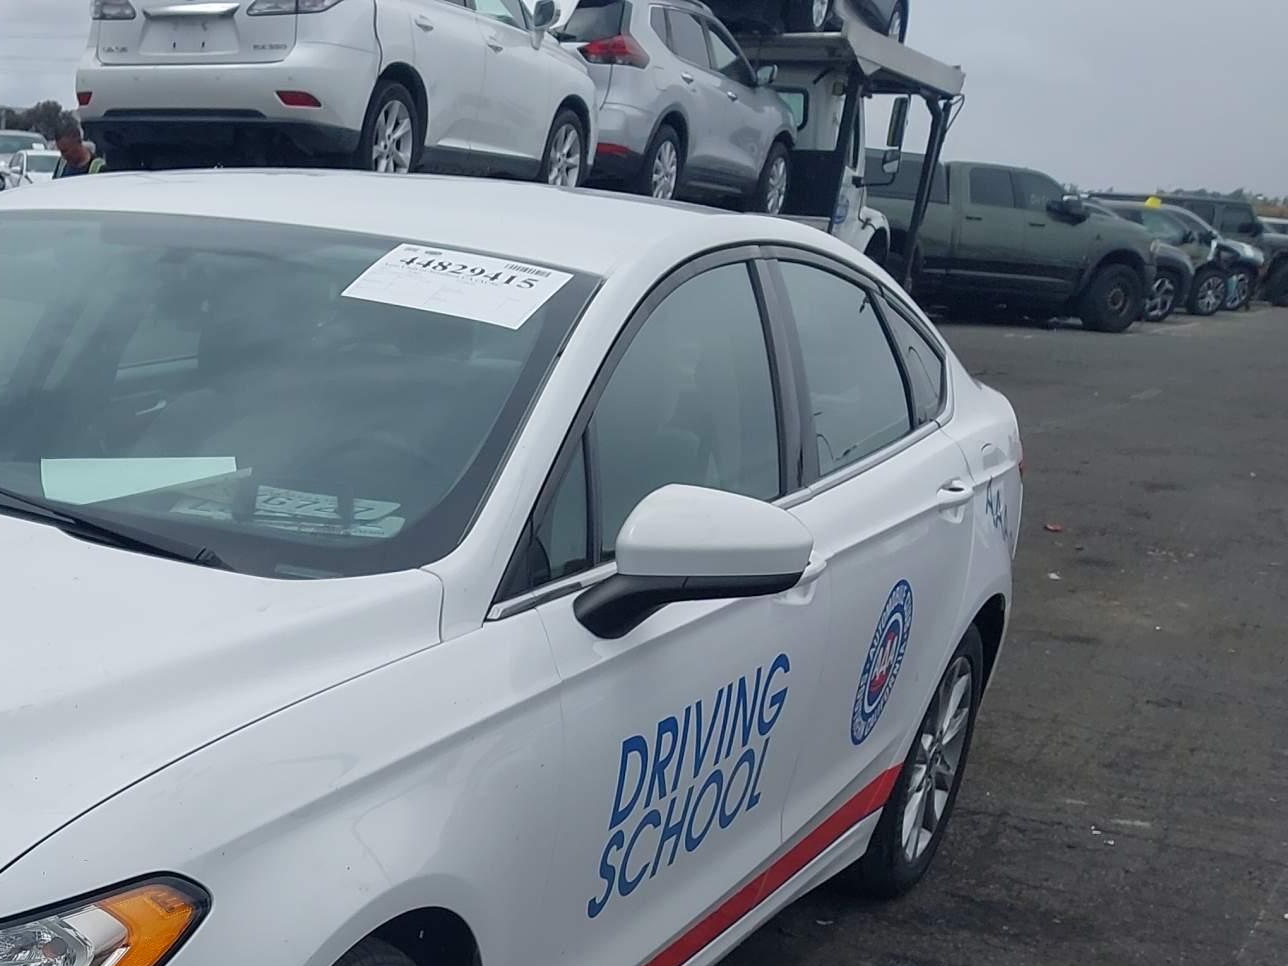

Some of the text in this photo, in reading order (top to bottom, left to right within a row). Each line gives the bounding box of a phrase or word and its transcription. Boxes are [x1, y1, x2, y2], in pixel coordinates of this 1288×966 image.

[399, 256, 539, 289] 44829415
[587, 737, 770, 918] SCHOOL
[609, 653, 790, 830] DRIVING
